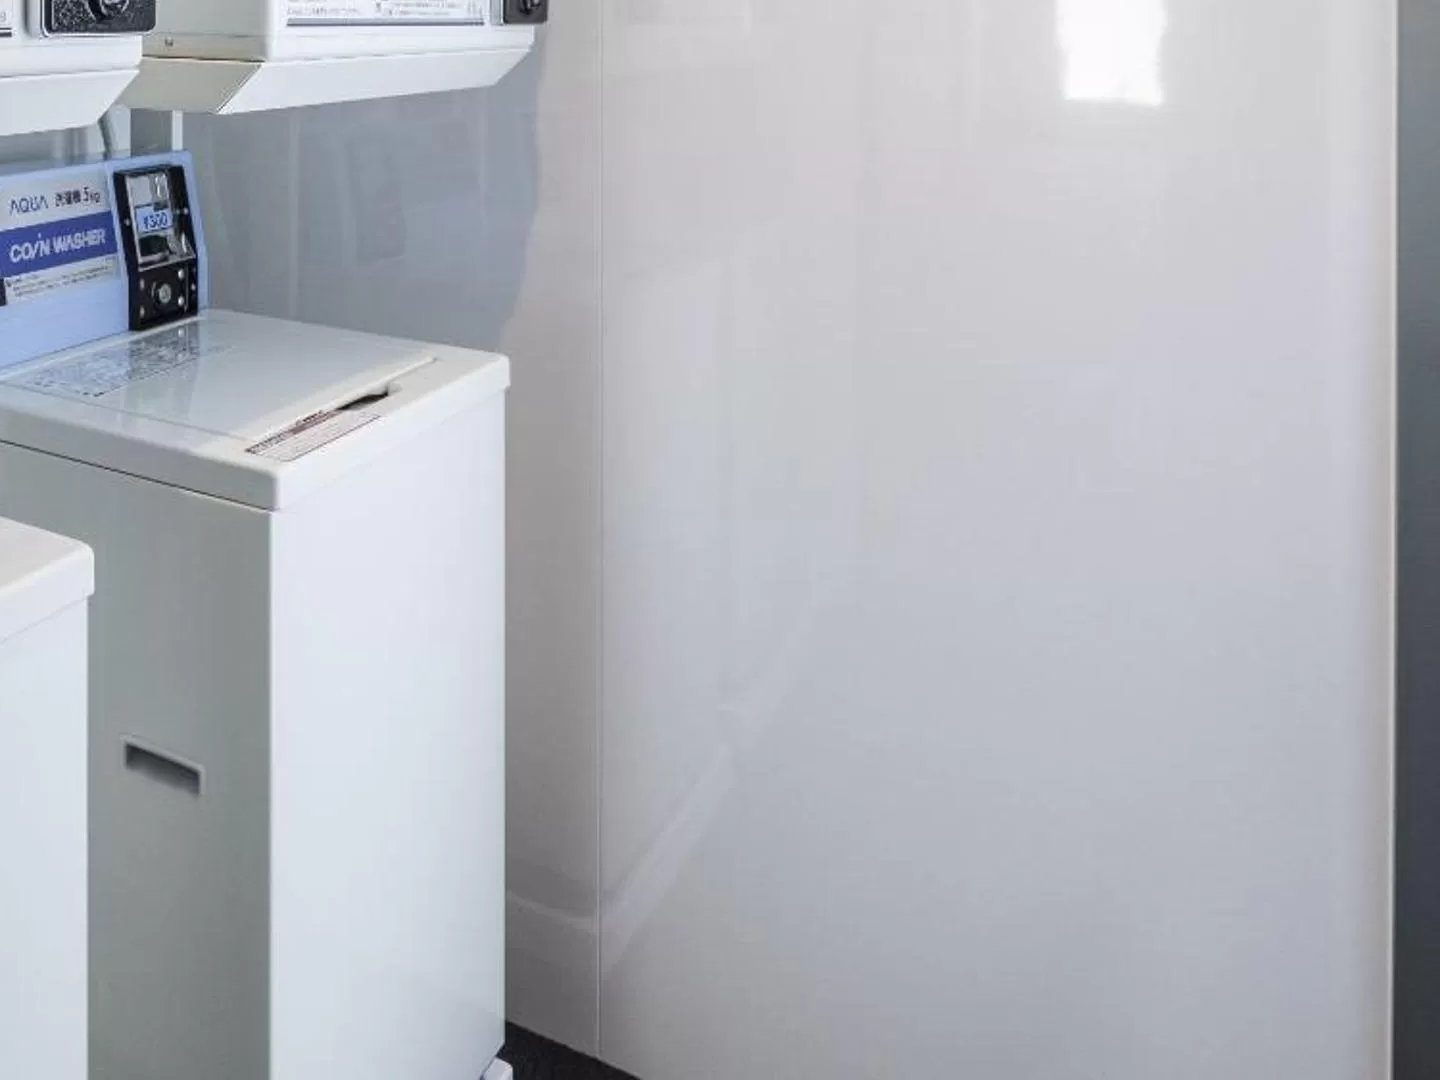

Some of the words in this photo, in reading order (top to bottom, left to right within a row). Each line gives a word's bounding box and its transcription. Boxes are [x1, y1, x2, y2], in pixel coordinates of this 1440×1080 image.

[9, 194, 49, 216] AQUA
[9, 231, 51, 263] COIN
[52, 228, 106, 254] WASHER
